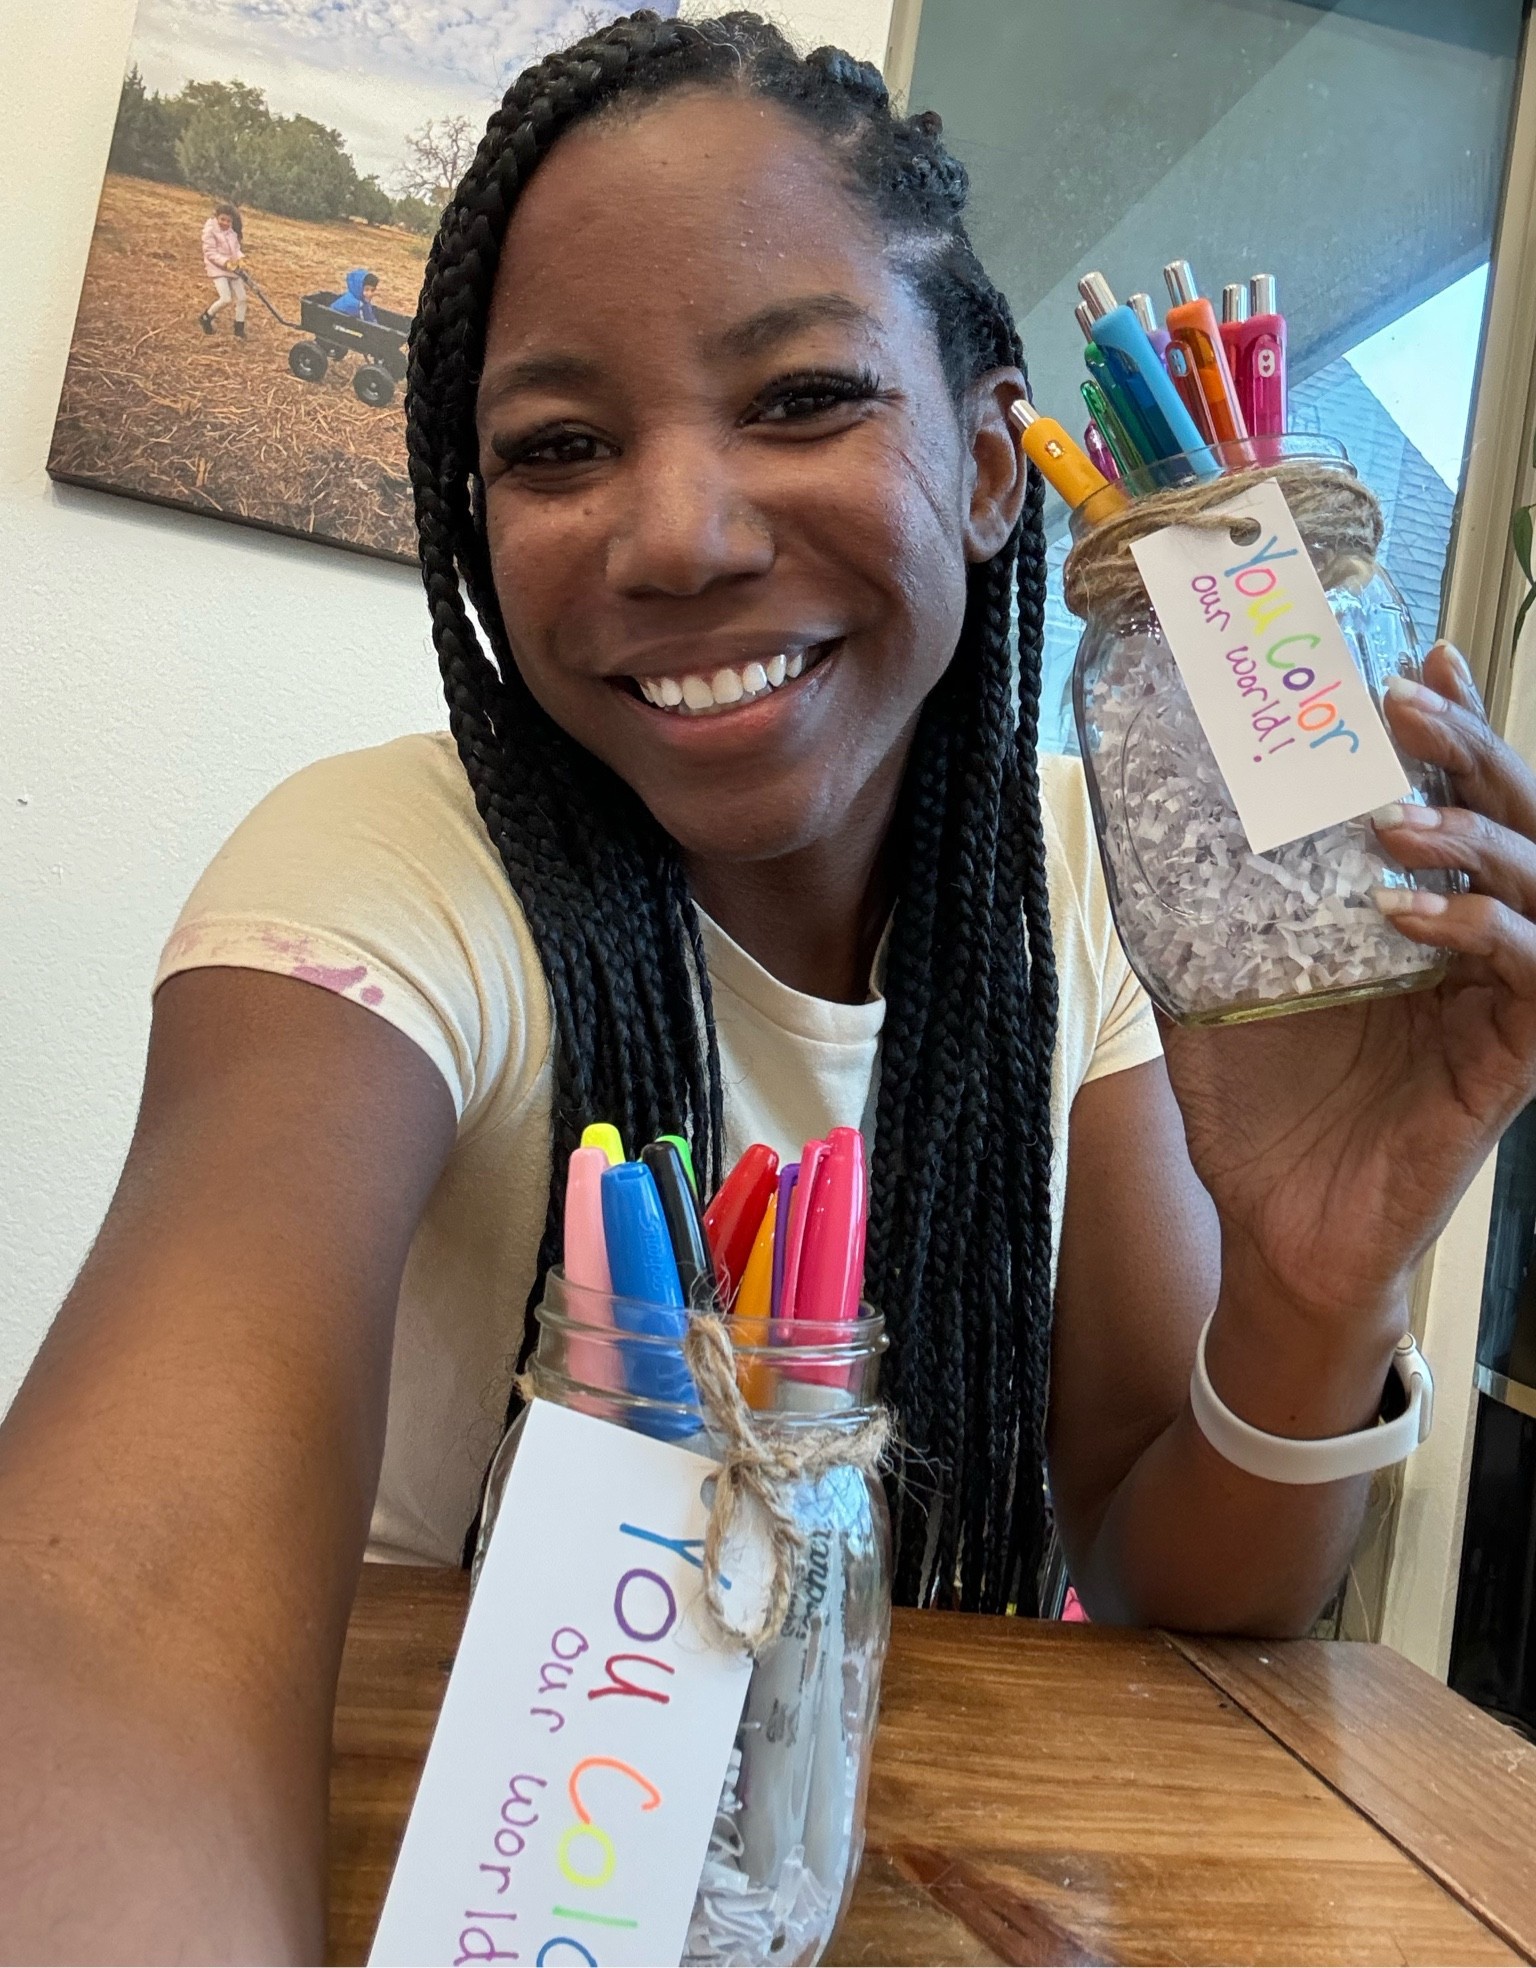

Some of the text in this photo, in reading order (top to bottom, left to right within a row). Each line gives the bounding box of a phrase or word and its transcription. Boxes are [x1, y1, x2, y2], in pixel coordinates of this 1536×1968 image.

[1190, 574, 1296, 763] our world!
[1224, 535, 1360, 754] You Color
[586, 1521, 733, 1705] You
[452, 1626, 590, 1967] our world
